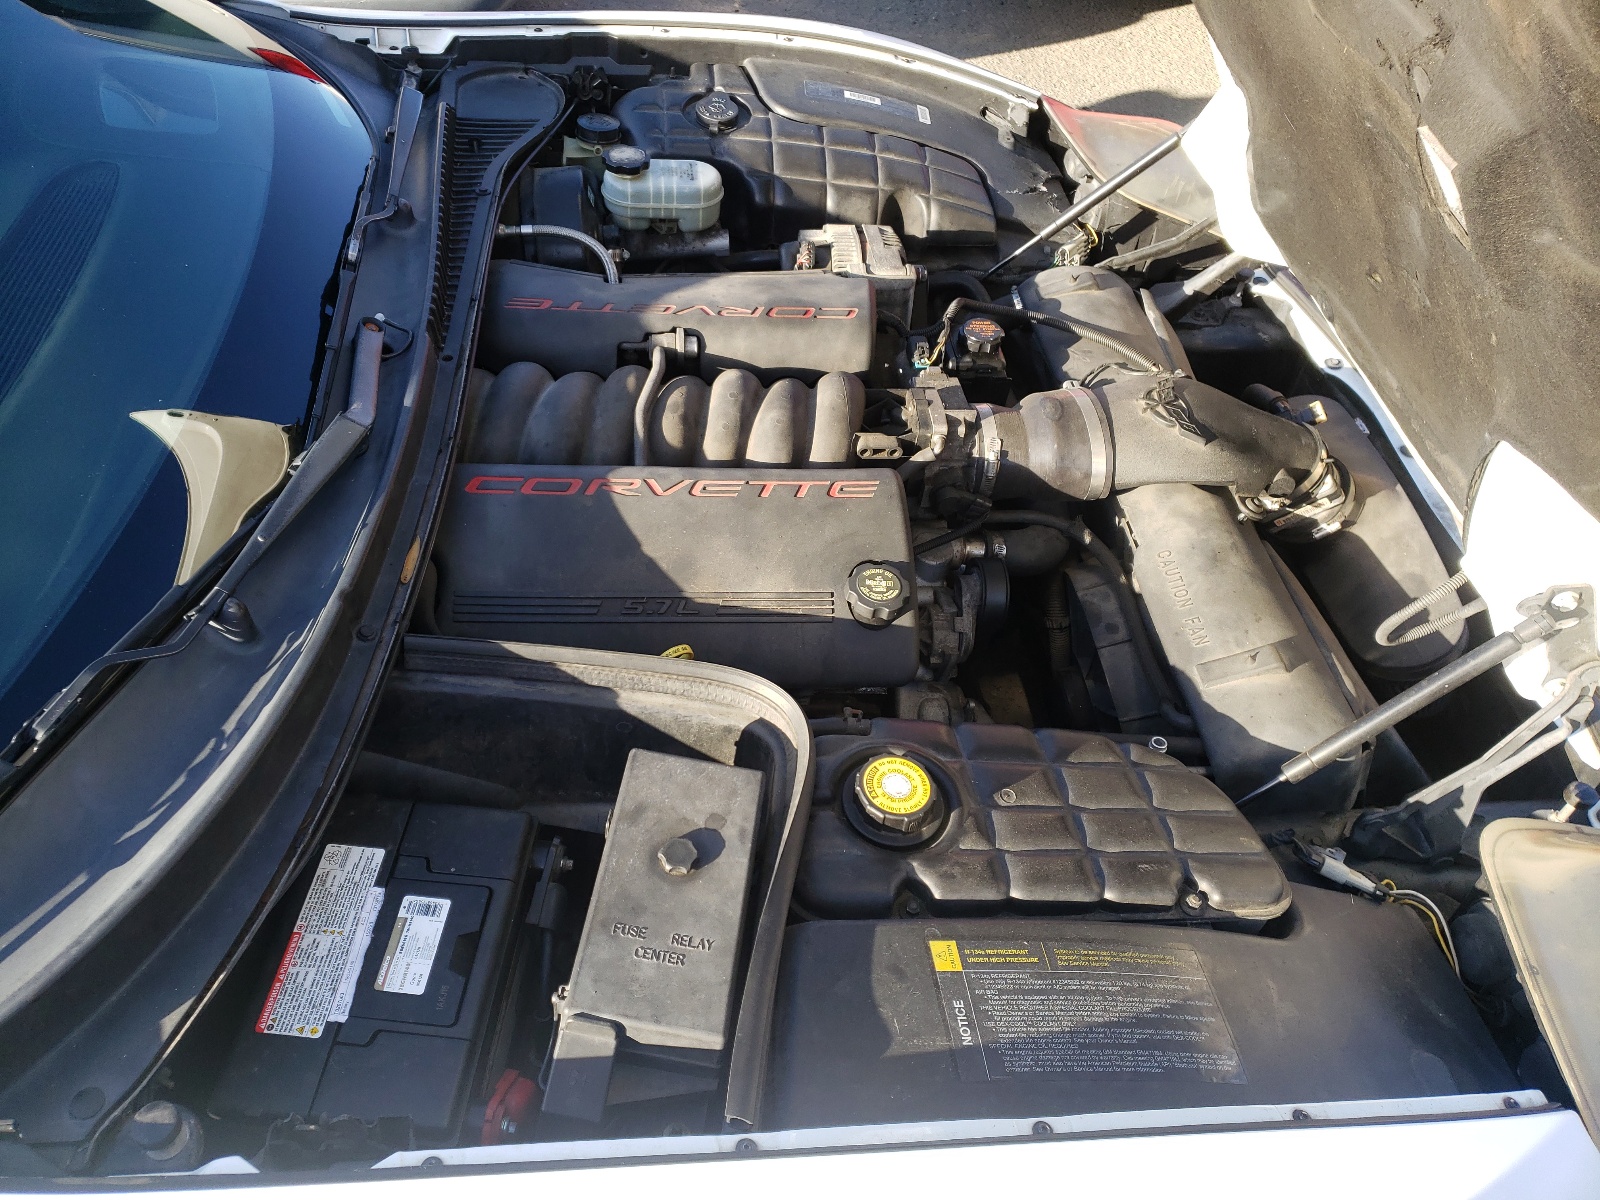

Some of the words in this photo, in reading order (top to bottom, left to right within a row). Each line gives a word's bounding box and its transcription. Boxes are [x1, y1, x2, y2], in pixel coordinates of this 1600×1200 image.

[503, 297, 858, 319] CORVETTE
[464, 475, 880, 499] CORVETTE
[621, 598, 699, 615] 5.7L
[1157, 549, 1193, 609] CAUTION
[1184, 616, 1211, 647] FAN
[866, 766, 879, 794] CAUTION
[888, 768, 915, 782] COOLANT
[879, 802, 902, 812] REMOVE
[612, 922, 648, 940] FUSE
[670, 932, 716, 952] RELAY
[634, 946, 686, 967] CENTER
[947, 944, 956, 969] CAUTION
[376, 955, 391, 985] ACDelco
[953, 1000, 973, 1046] NOTICE
